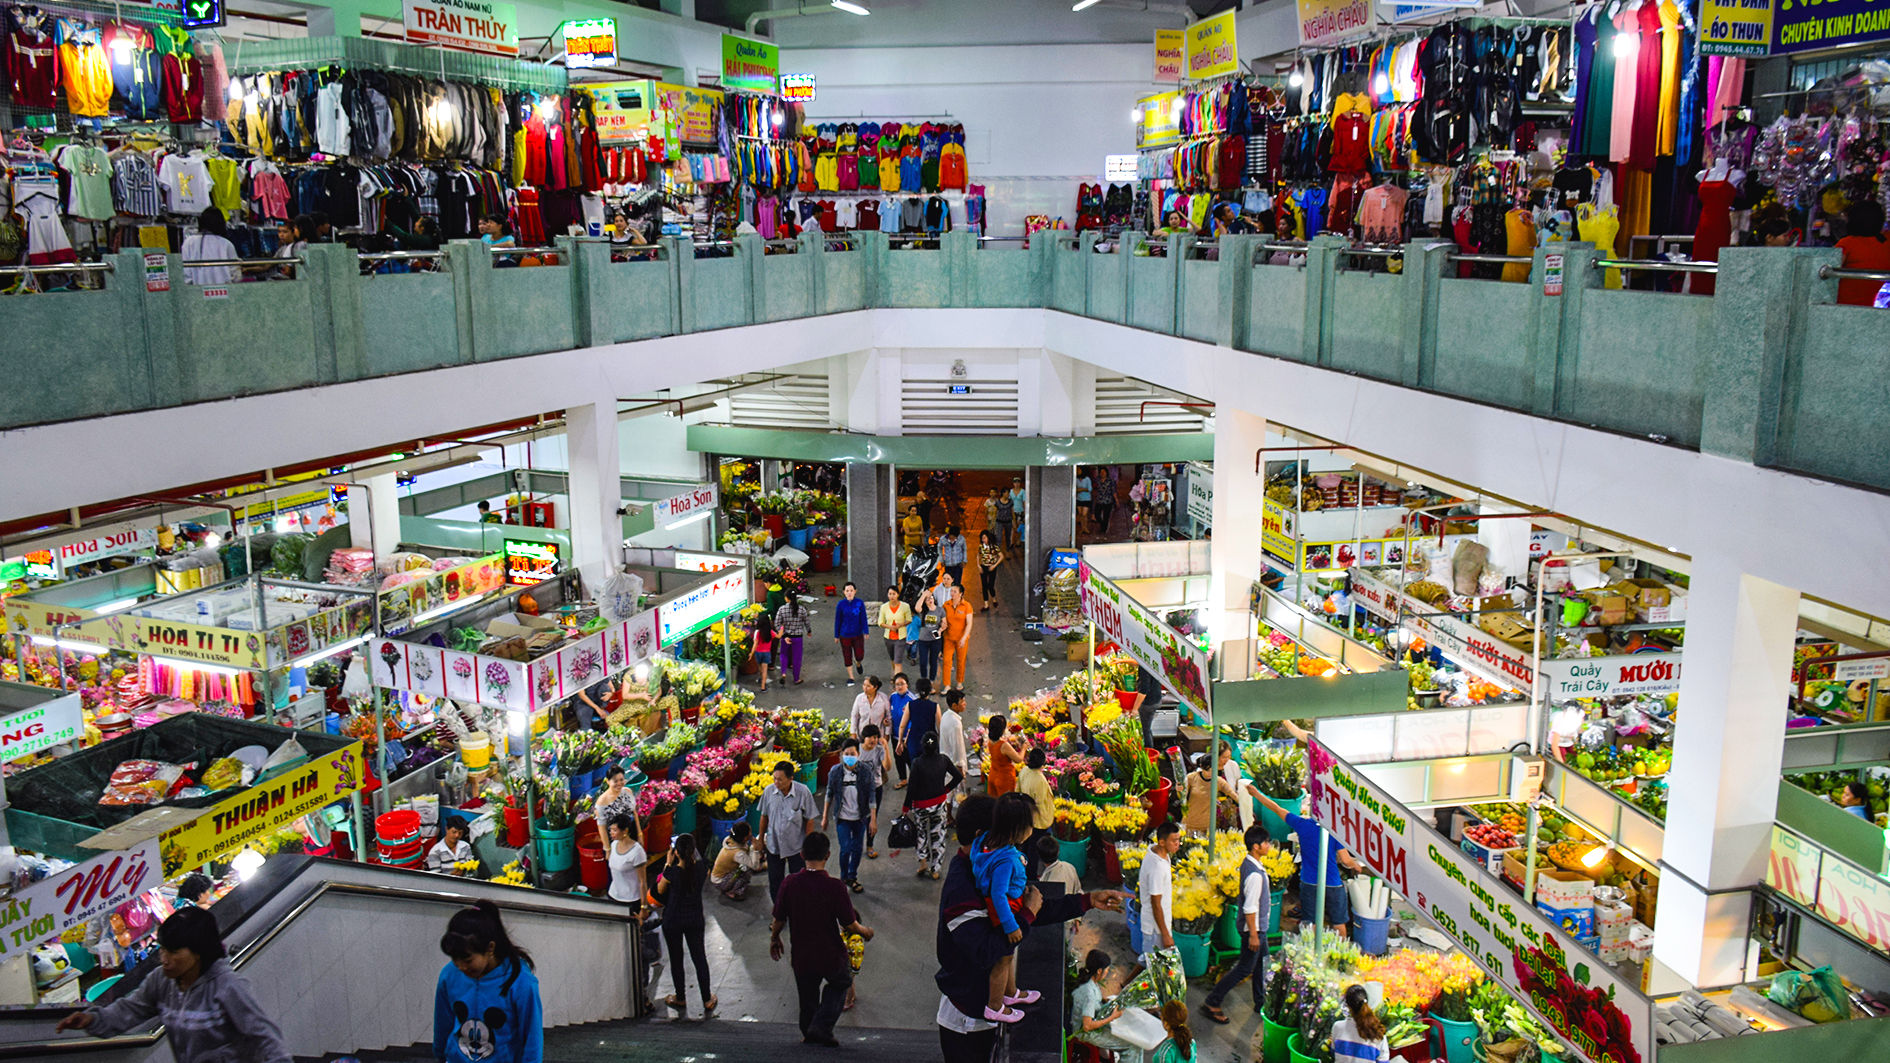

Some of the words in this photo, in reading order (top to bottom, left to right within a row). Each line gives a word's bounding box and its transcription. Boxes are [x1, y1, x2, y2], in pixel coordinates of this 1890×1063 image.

[413, 6, 462, 34] TRÂN
[464, 15, 507, 41] THỦY
[1304, 8, 1336, 41] NGHĨA
[1337, 0, 1368, 31] CHÂU
[1710, 15, 1729, 39] ÁO
[1732, 21, 1764, 41] THUN
[1780, 16, 1824, 45] CHUYÊN
[1825, 14, 1854, 39] KINH
[1157, 48, 1181, 58] NGHĨA
[1158, 63, 1180, 74] CHÂU
[670, 498, 691, 515] Hoa
[62, 539, 98, 559] Hoa
[1088, 588, 1124, 645] THƠM
[148, 626, 188, 647] HOA
[196, 630, 213, 651] TI
[221, 634, 239, 654] TI
[1560, 681, 1583, 693] Trái
[1586, 679, 1610, 692] Cây
[1618, 659, 1674, 683] MƯỜI
[212, 785, 286, 835] THUẬN
[292, 769, 319, 799] HÀ
[214, 822, 266, 853] 0916340454
[273, 793, 328, 825] 0124.5515891
[1325, 783, 1410, 898] THƠM
[56, 850, 149, 915] Mỹ
[10, 913, 55, 947] TƯƠI
[1469, 902, 1491, 933] hoa
[1469, 879, 1495, 912] cung
[1497, 902, 1518, 929] cấp
[1520, 920, 1540, 947] các
[1543, 936, 1567, 971] loại
